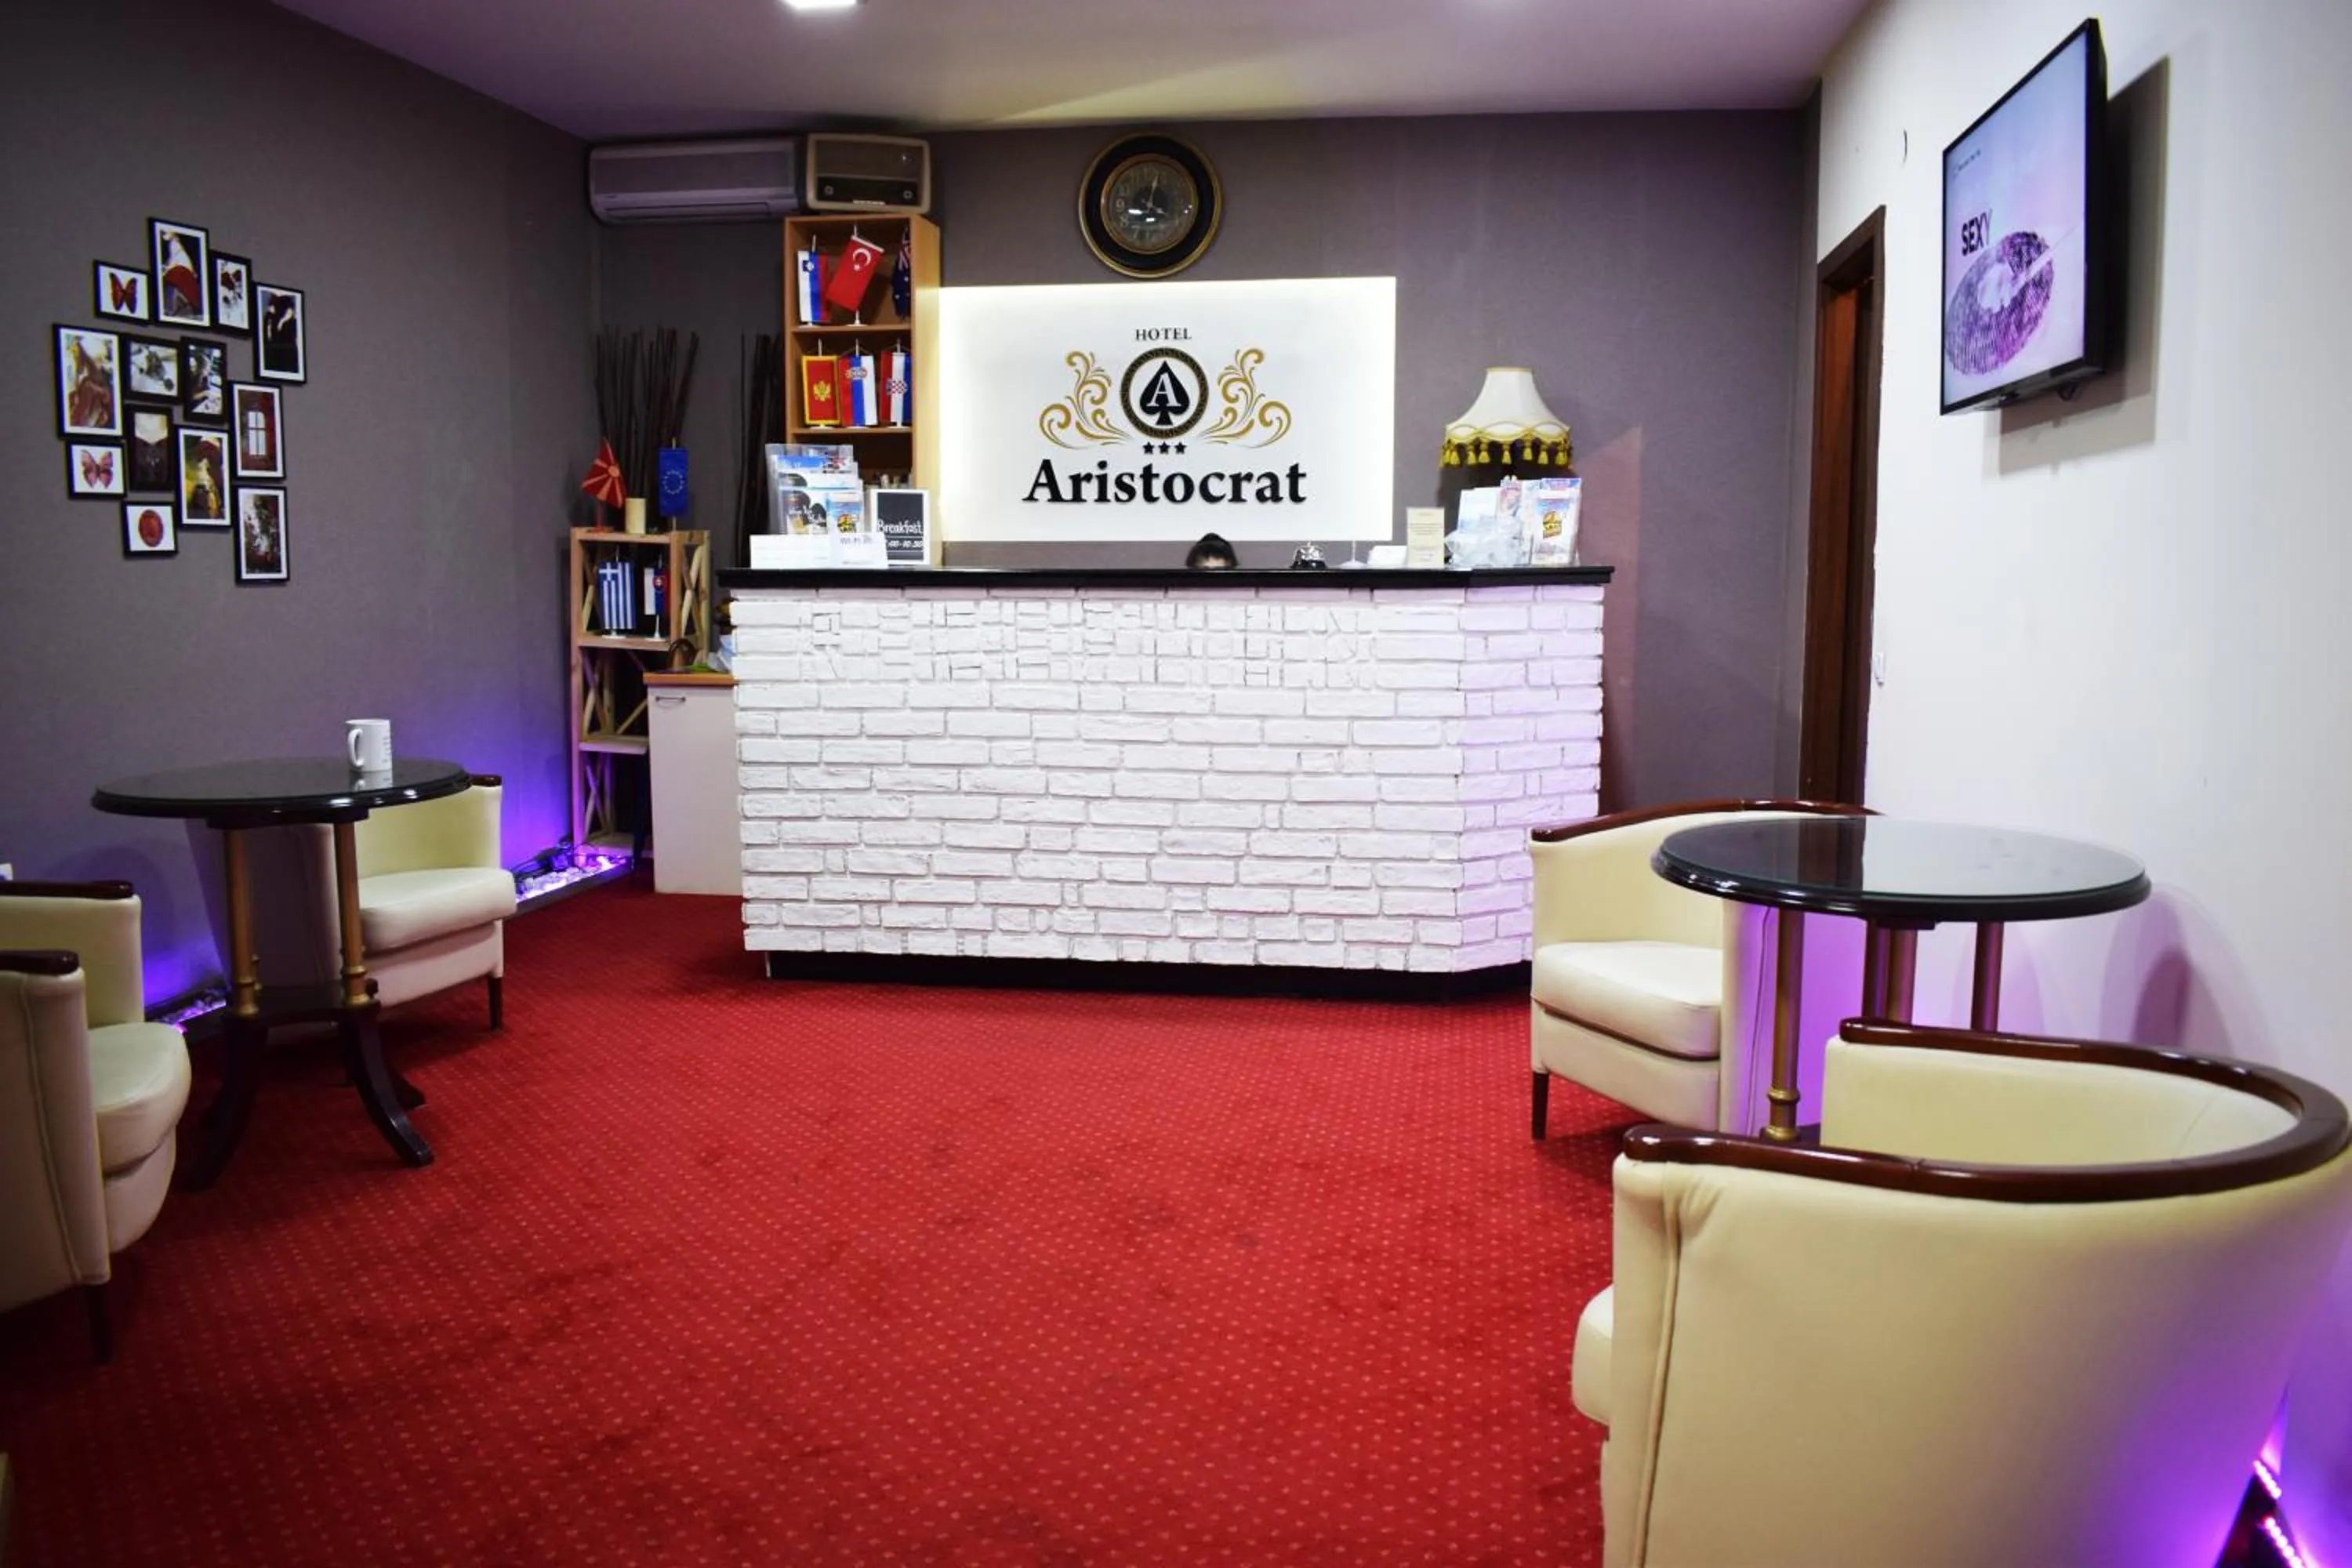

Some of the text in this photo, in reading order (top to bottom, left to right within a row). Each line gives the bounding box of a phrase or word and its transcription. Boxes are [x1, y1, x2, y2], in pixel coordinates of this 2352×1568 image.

[1962, 208, 1993, 256] SEXY
[1135, 327, 1192, 341] HOTEL
[1146, 372, 1181, 407] A
[1022, 458, 1308, 504] Aristocrat
[877, 519, 924, 535] Breakfast
